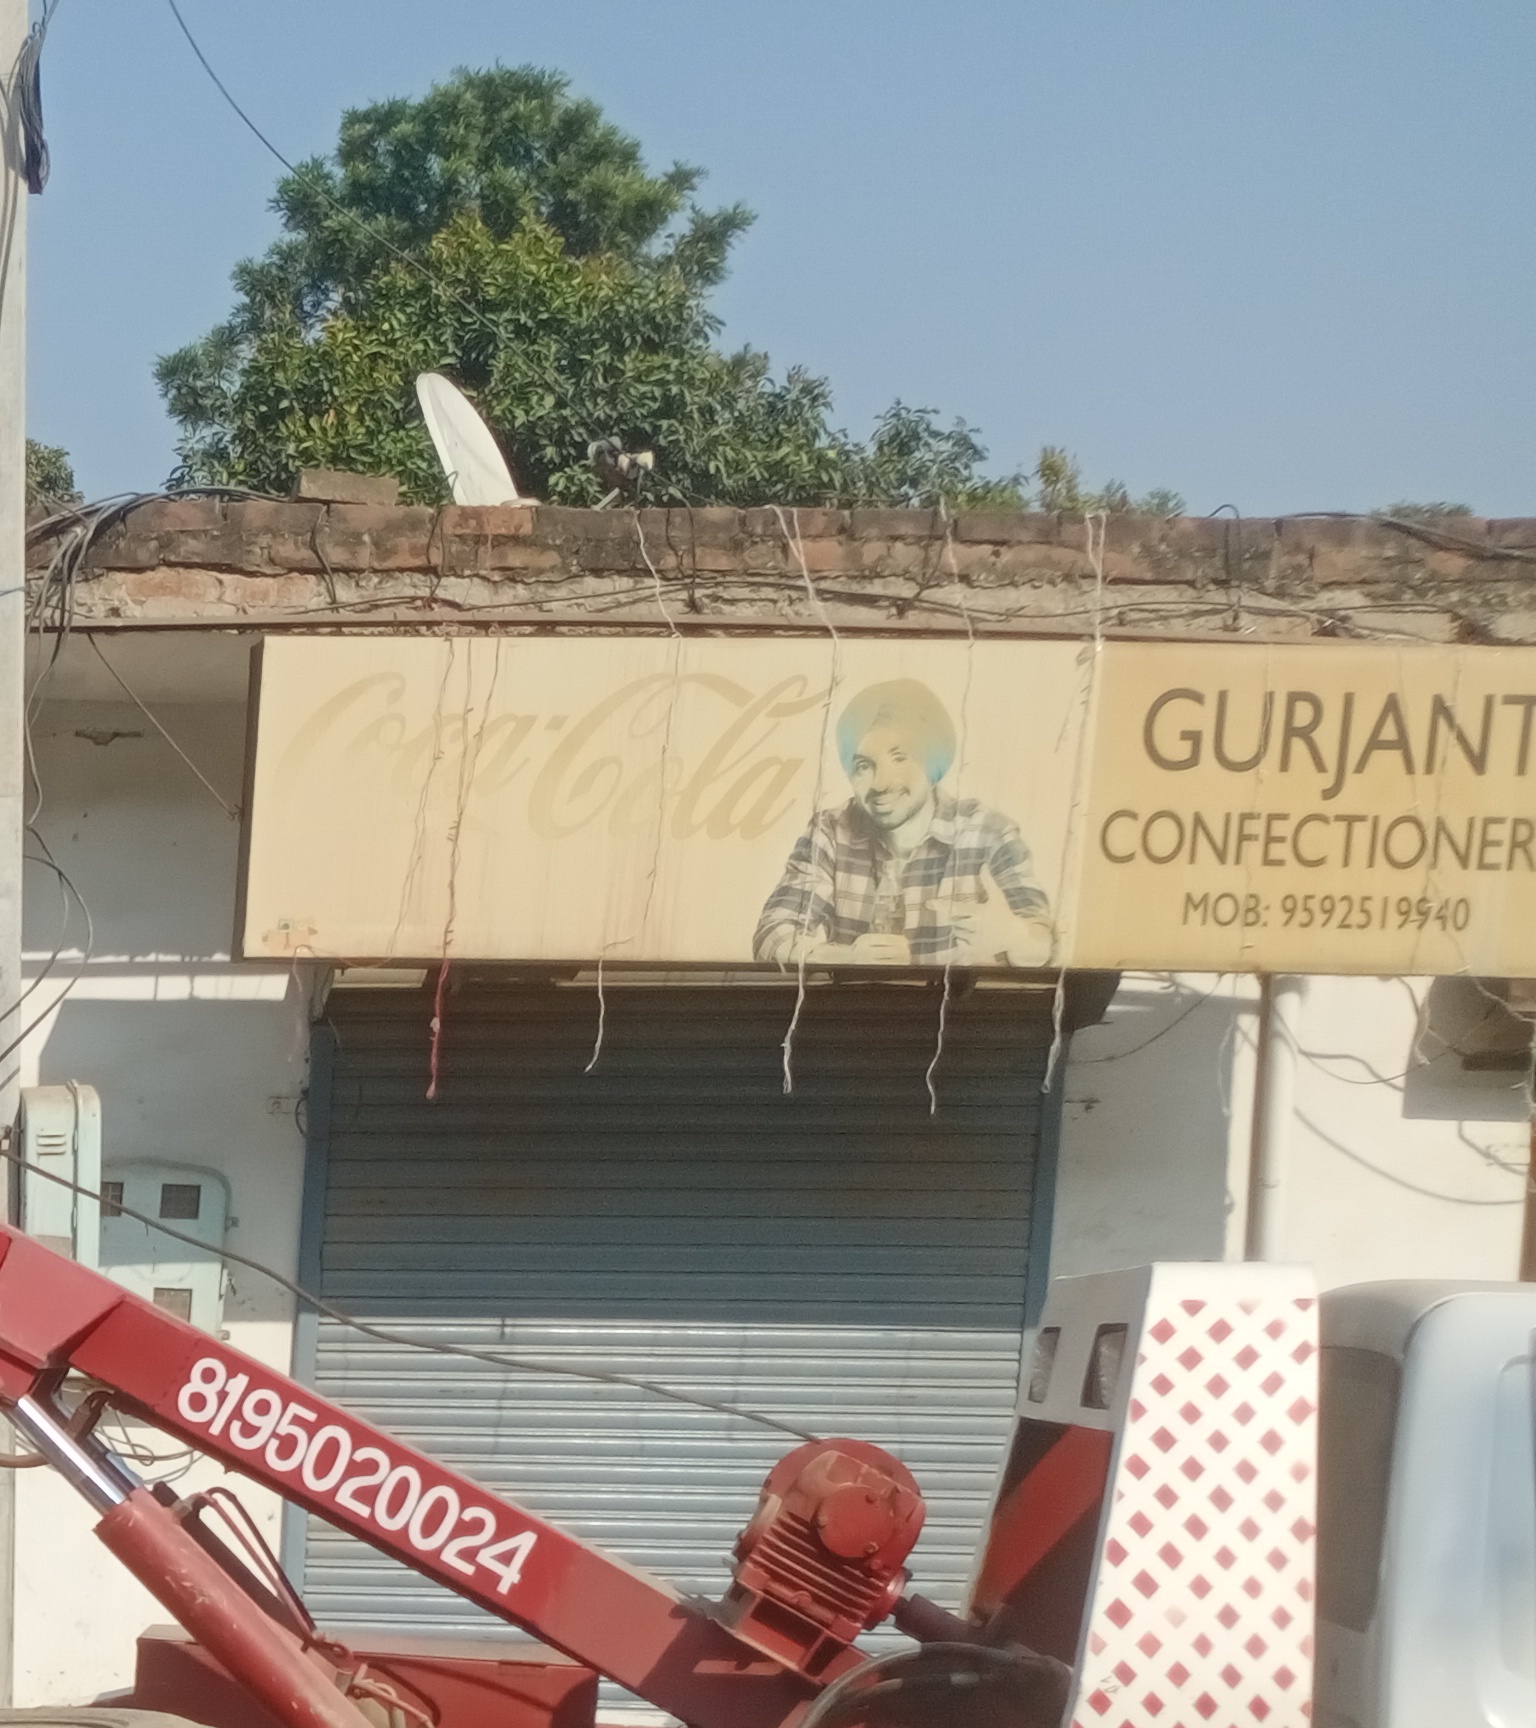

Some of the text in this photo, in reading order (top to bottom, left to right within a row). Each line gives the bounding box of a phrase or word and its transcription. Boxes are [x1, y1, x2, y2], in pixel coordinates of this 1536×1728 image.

[1143, 688, 1536, 801] GURJANT
[1182, 892, 1268, 928] MOB:
[177, 1357, 538, 1595] 8195020024
